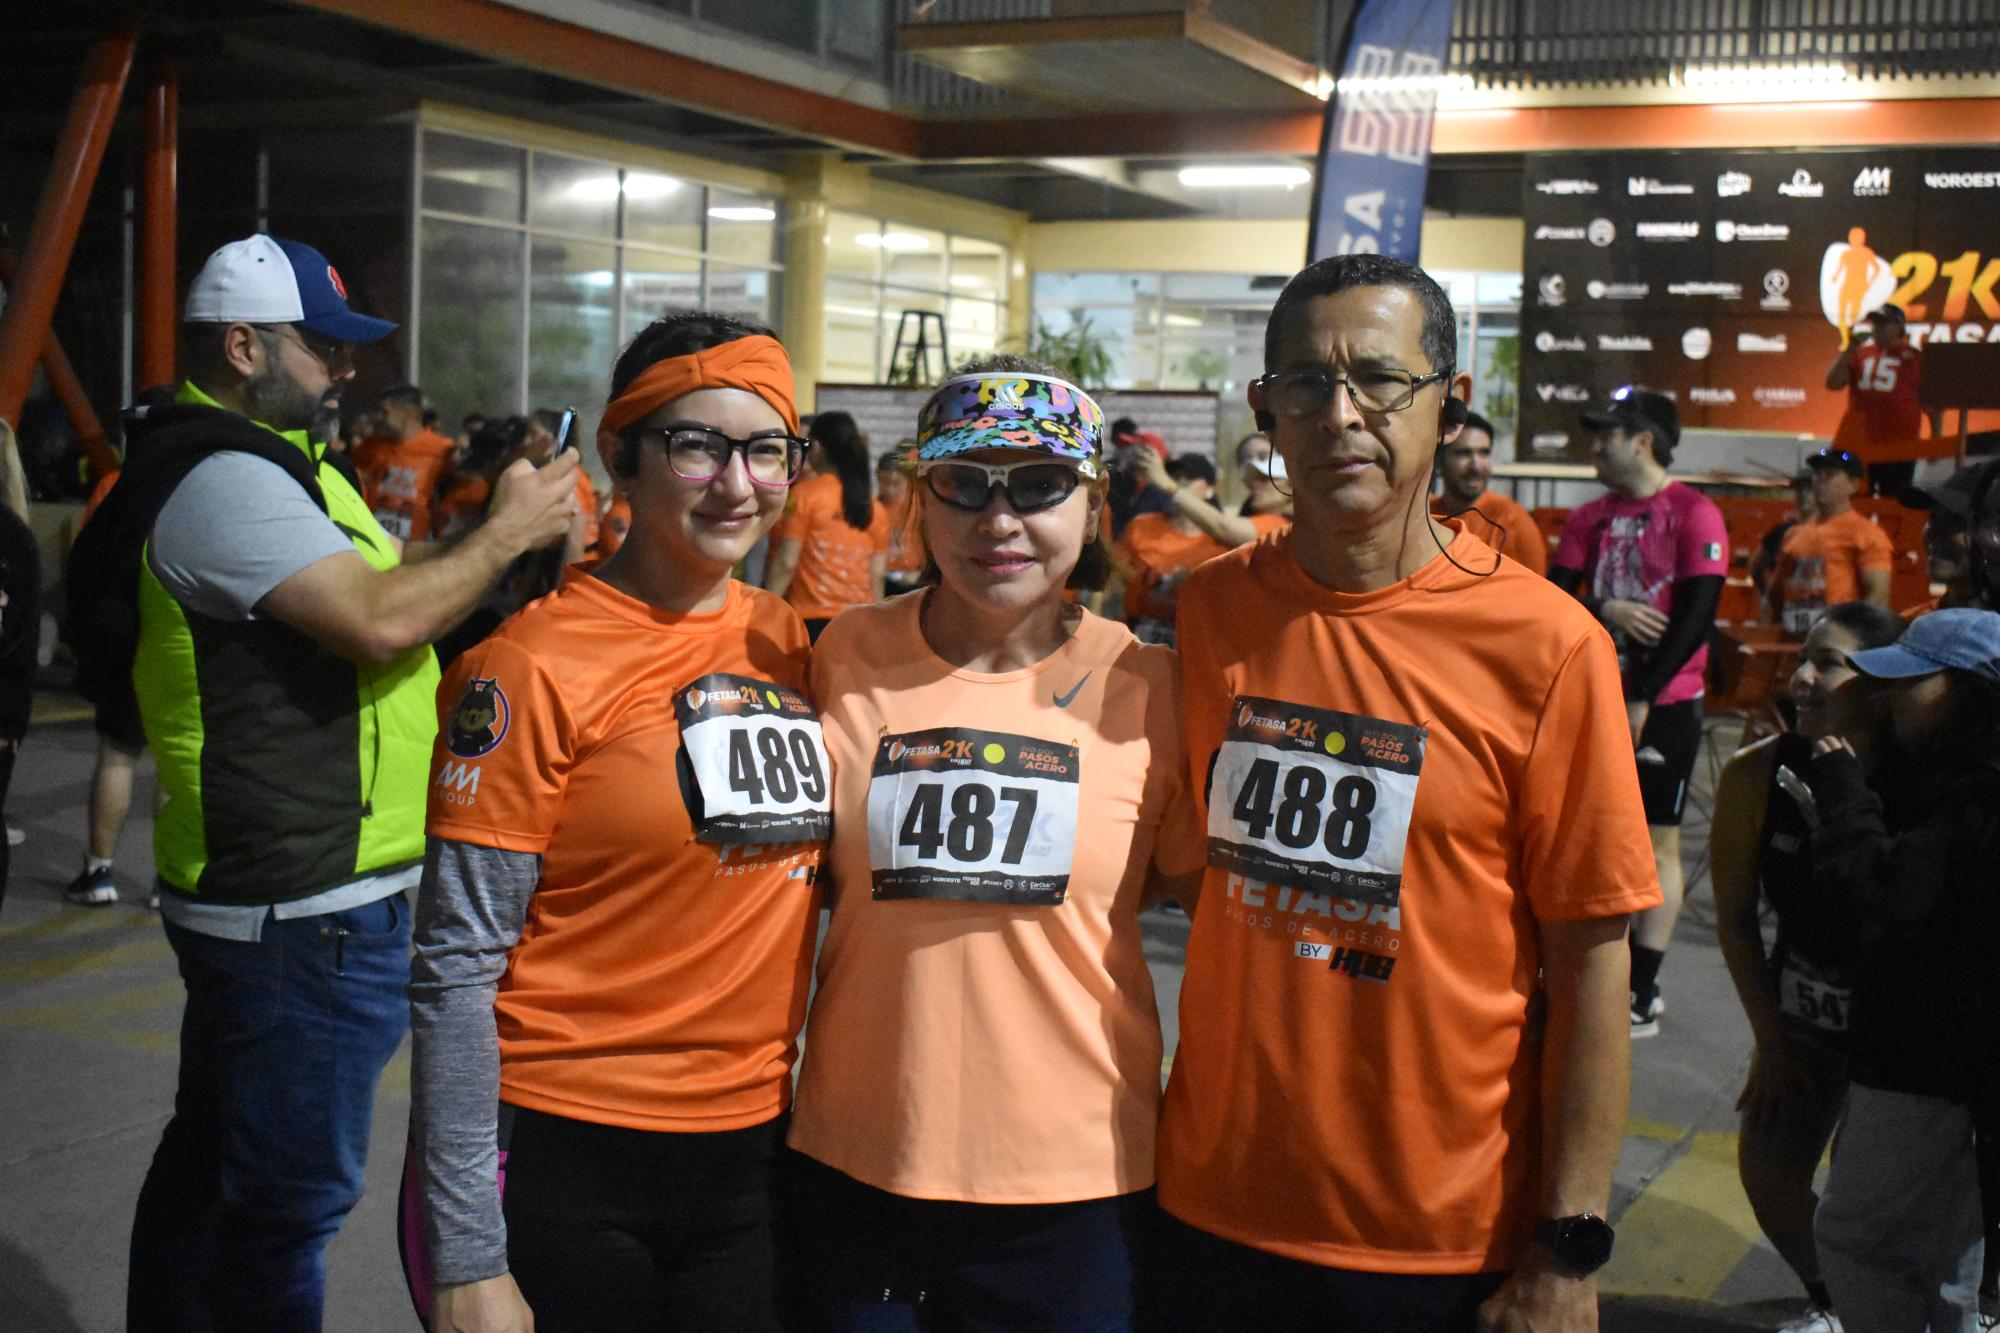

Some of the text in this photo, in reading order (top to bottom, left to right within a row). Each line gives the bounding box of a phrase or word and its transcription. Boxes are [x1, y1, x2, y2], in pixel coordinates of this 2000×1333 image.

[1858, 355, 1900, 393] 15
[988, 400, 1025, 411] adidas
[707, 690, 741, 702] FETASA
[1251, 716, 1318, 740] FETASA 21K
[904, 740, 974, 759] FETASA 21K
[1361, 736, 1404, 752] PASOS
[1018, 751, 1060, 764] PASOS
[1366, 748, 1409, 764] ACERO
[729, 727, 826, 805] 489
[1024, 761, 1068, 774] ACERO
[1233, 758, 1377, 860] 488
[899, 783, 1038, 865] 487
[1287, 920, 1313, 937] DE
[1329, 927, 1400, 951] ACERO
[1300, 944, 1322, 957] BY
[1797, 979, 1850, 1027] 54
